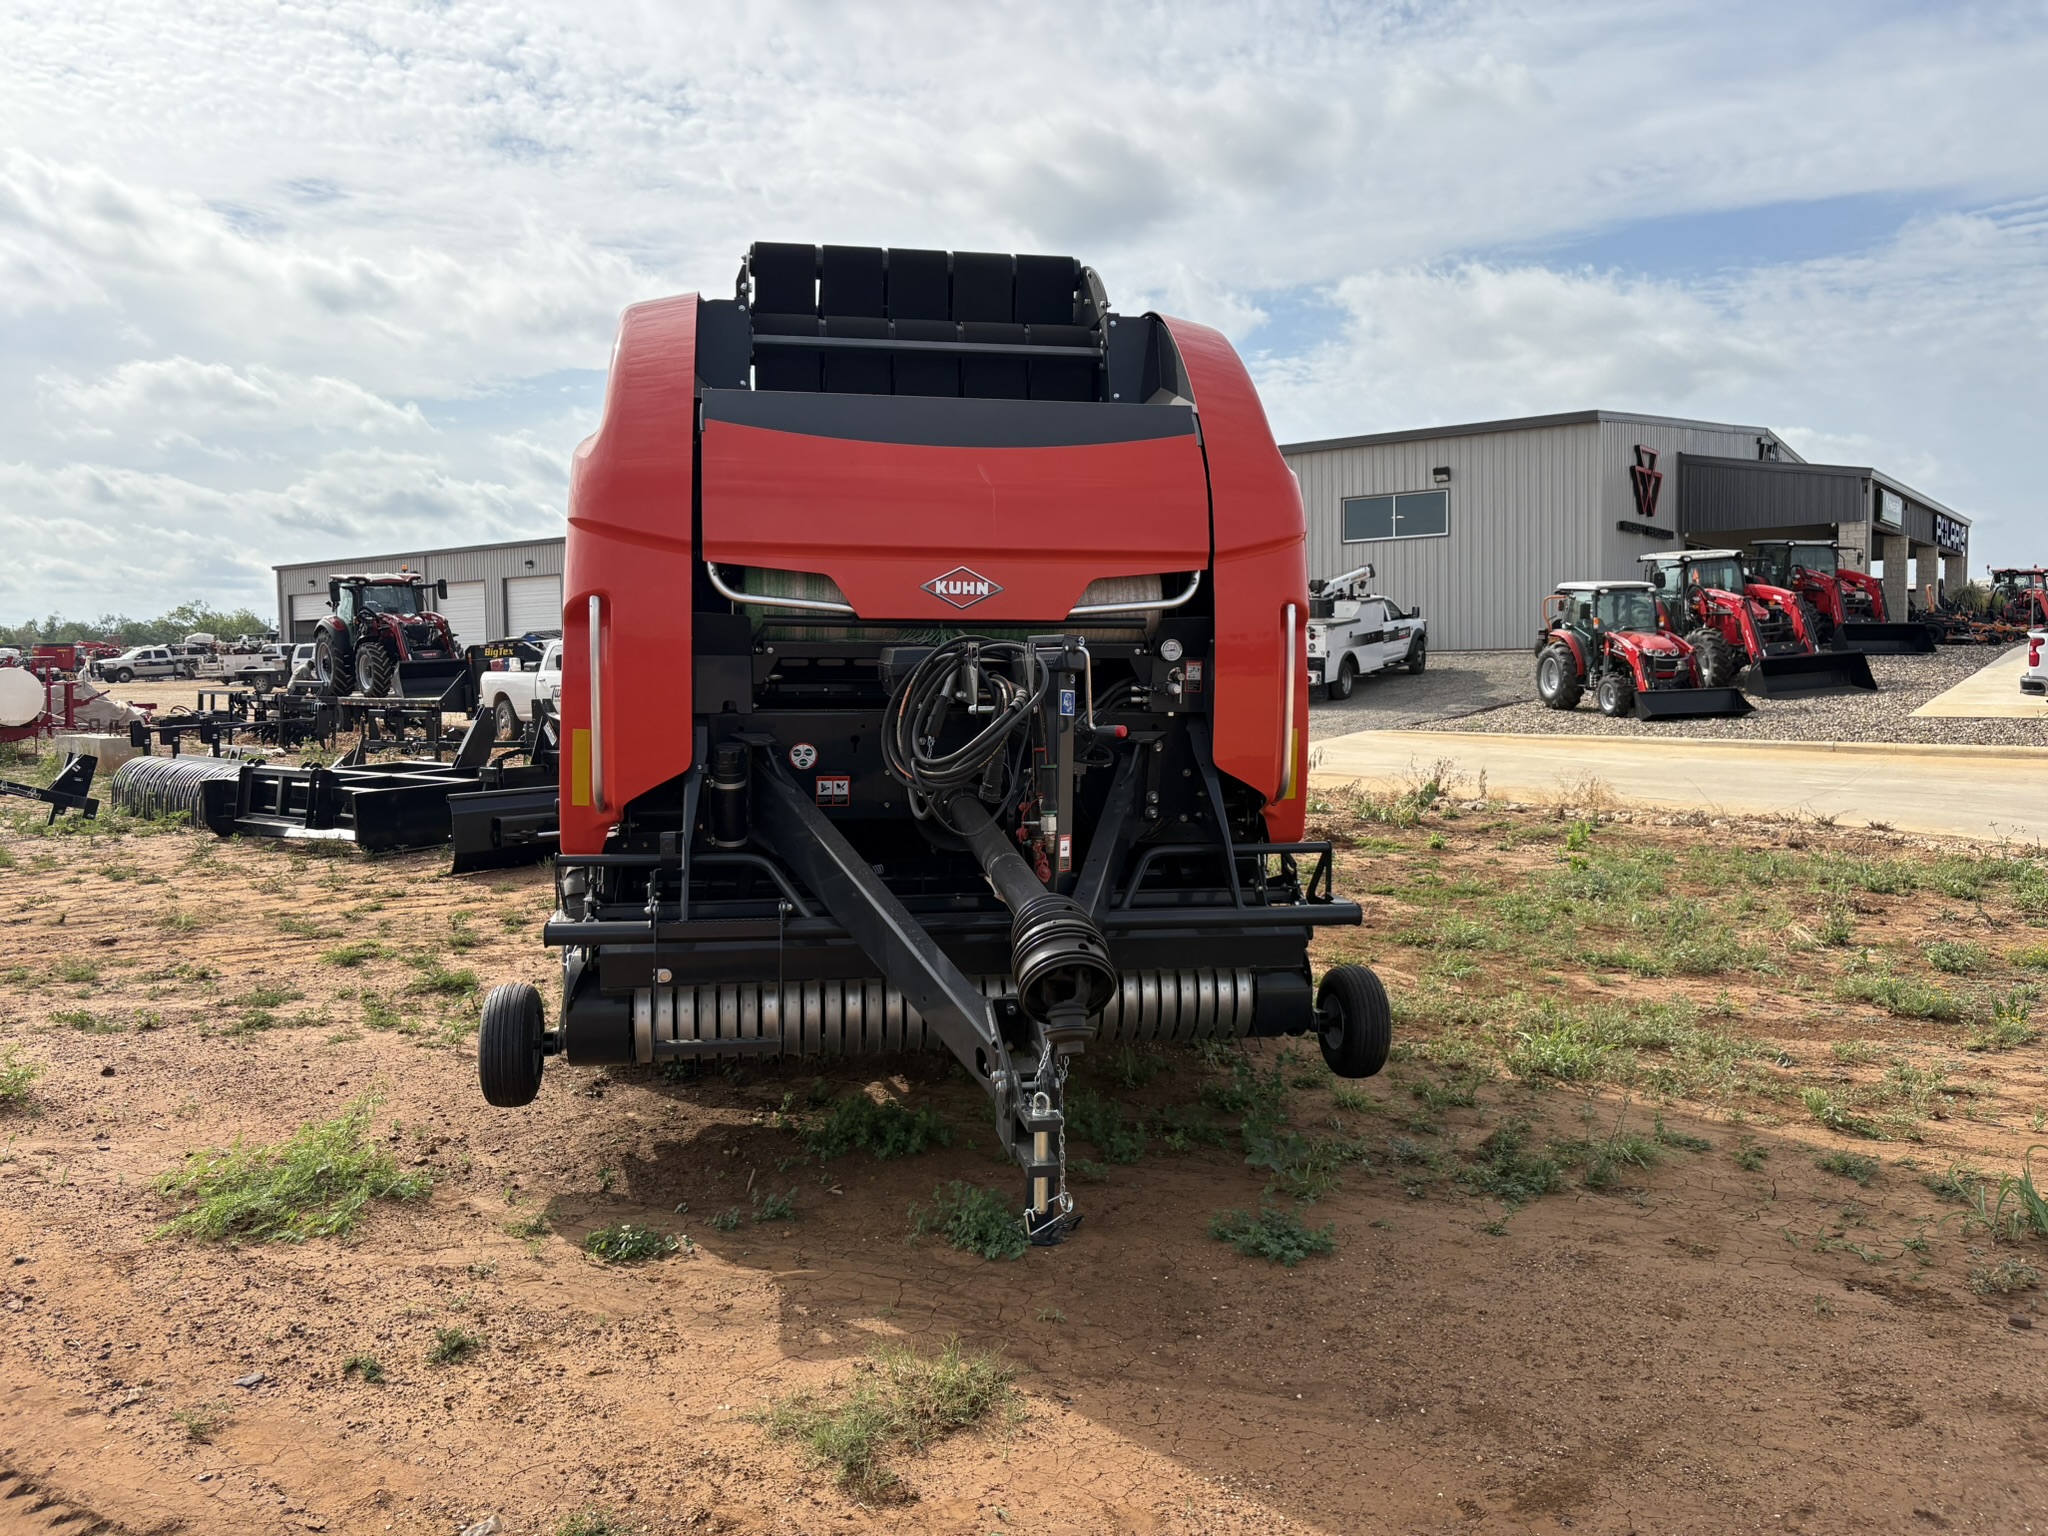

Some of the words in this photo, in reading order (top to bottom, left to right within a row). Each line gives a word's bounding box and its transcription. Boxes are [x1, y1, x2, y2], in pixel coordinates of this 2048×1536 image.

[1936, 514, 1966, 553] POLARIS
[935, 580, 989, 595] KUHN
[484, 647, 514, 658] BigTex
